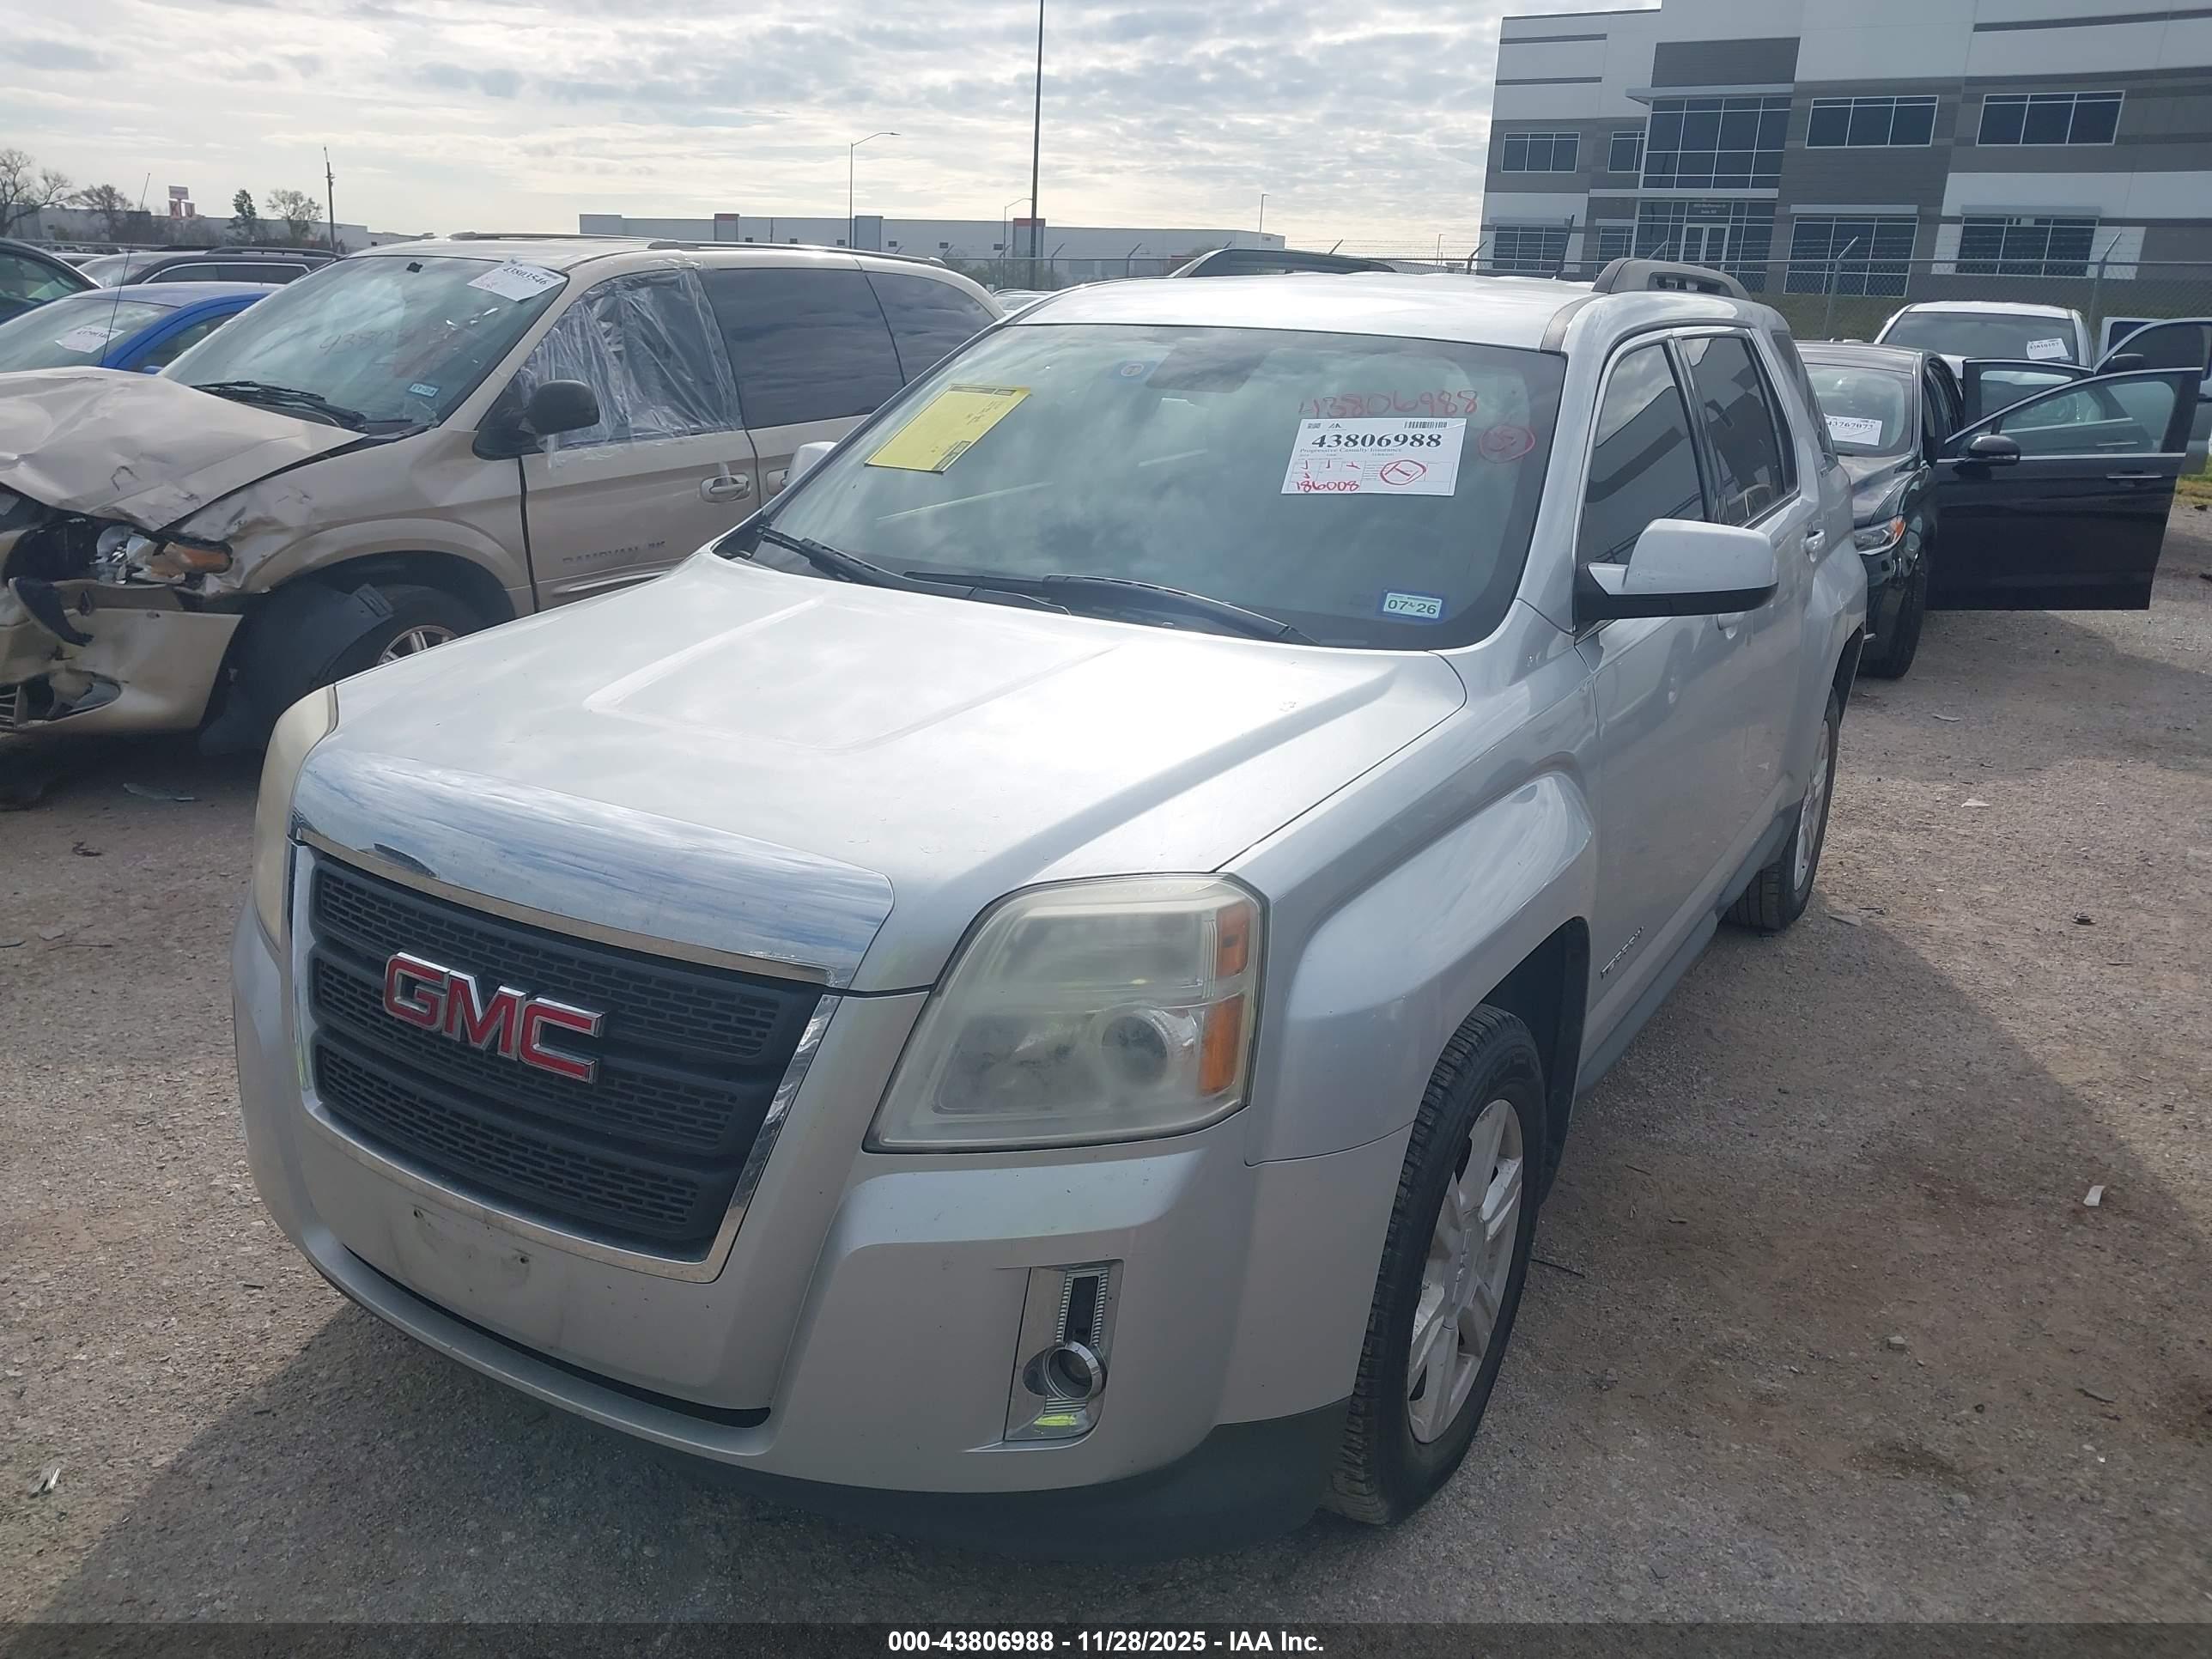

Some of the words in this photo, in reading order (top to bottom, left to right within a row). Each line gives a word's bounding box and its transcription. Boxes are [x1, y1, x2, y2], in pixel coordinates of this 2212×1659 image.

[1298, 390, 1478, 418] 43806988
[1311, 433, 1443, 447] 43806988
[1297, 480, 1360, 493] 186008
[1388, 599, 1408, 611] 07
[1416, 603, 1437, 615] 26
[383, 951, 605, 1085] GMC
